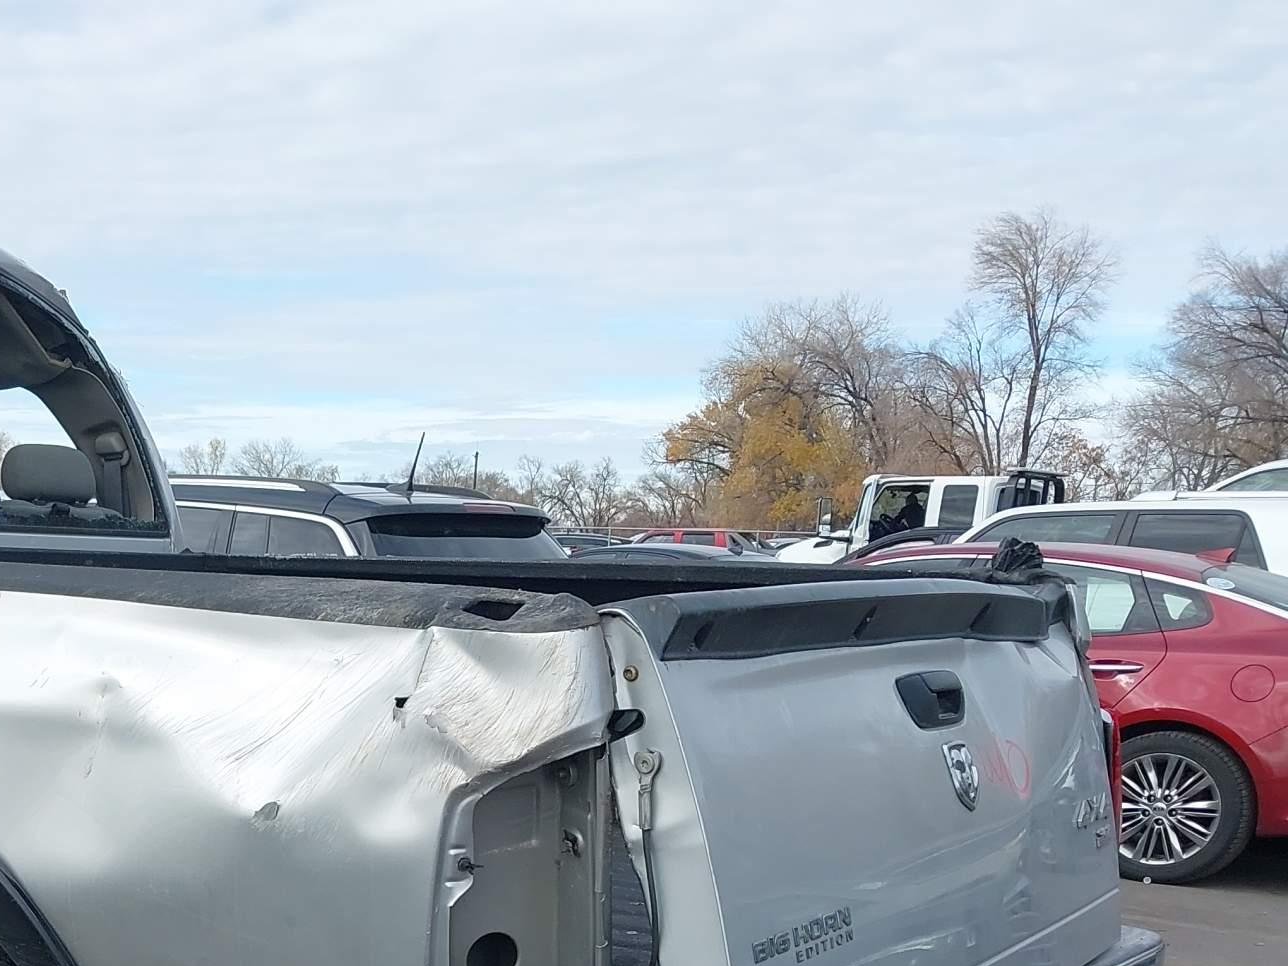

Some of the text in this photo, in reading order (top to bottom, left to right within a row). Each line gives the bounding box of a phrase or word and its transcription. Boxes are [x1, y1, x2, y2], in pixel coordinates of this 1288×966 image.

[752, 906, 853, 964] BIG HORN
[795, 928, 855, 964] EDITION
